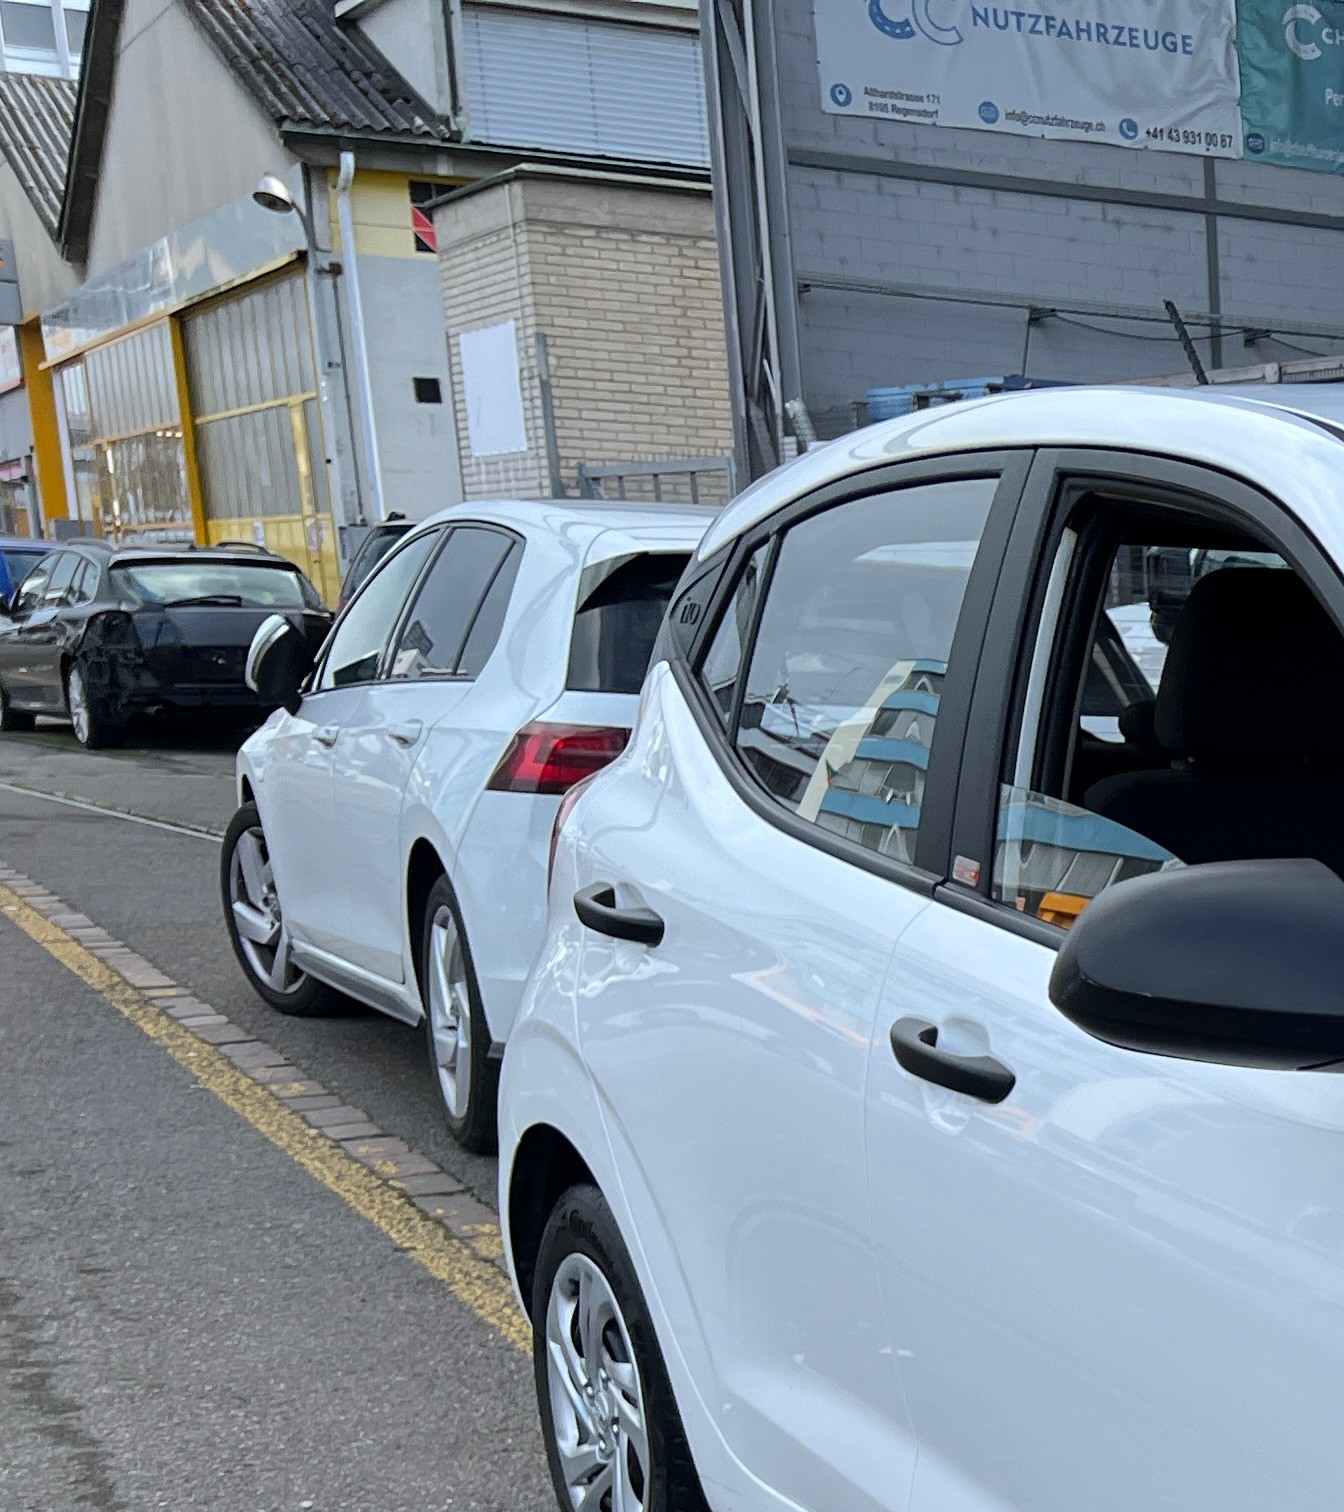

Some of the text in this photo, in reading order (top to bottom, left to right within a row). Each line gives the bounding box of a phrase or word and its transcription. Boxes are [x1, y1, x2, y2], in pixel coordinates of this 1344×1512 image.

[971, 6, 1194, 55] NUTZFAHRZEUGE
[1146, 127, 1164, 142] +41
[1167, 128, 1180, 143] 43
[1181, 130, 1202, 146] 931
[1205, 133, 1218, 147] 00
[680, 597, 701, 625] i10
